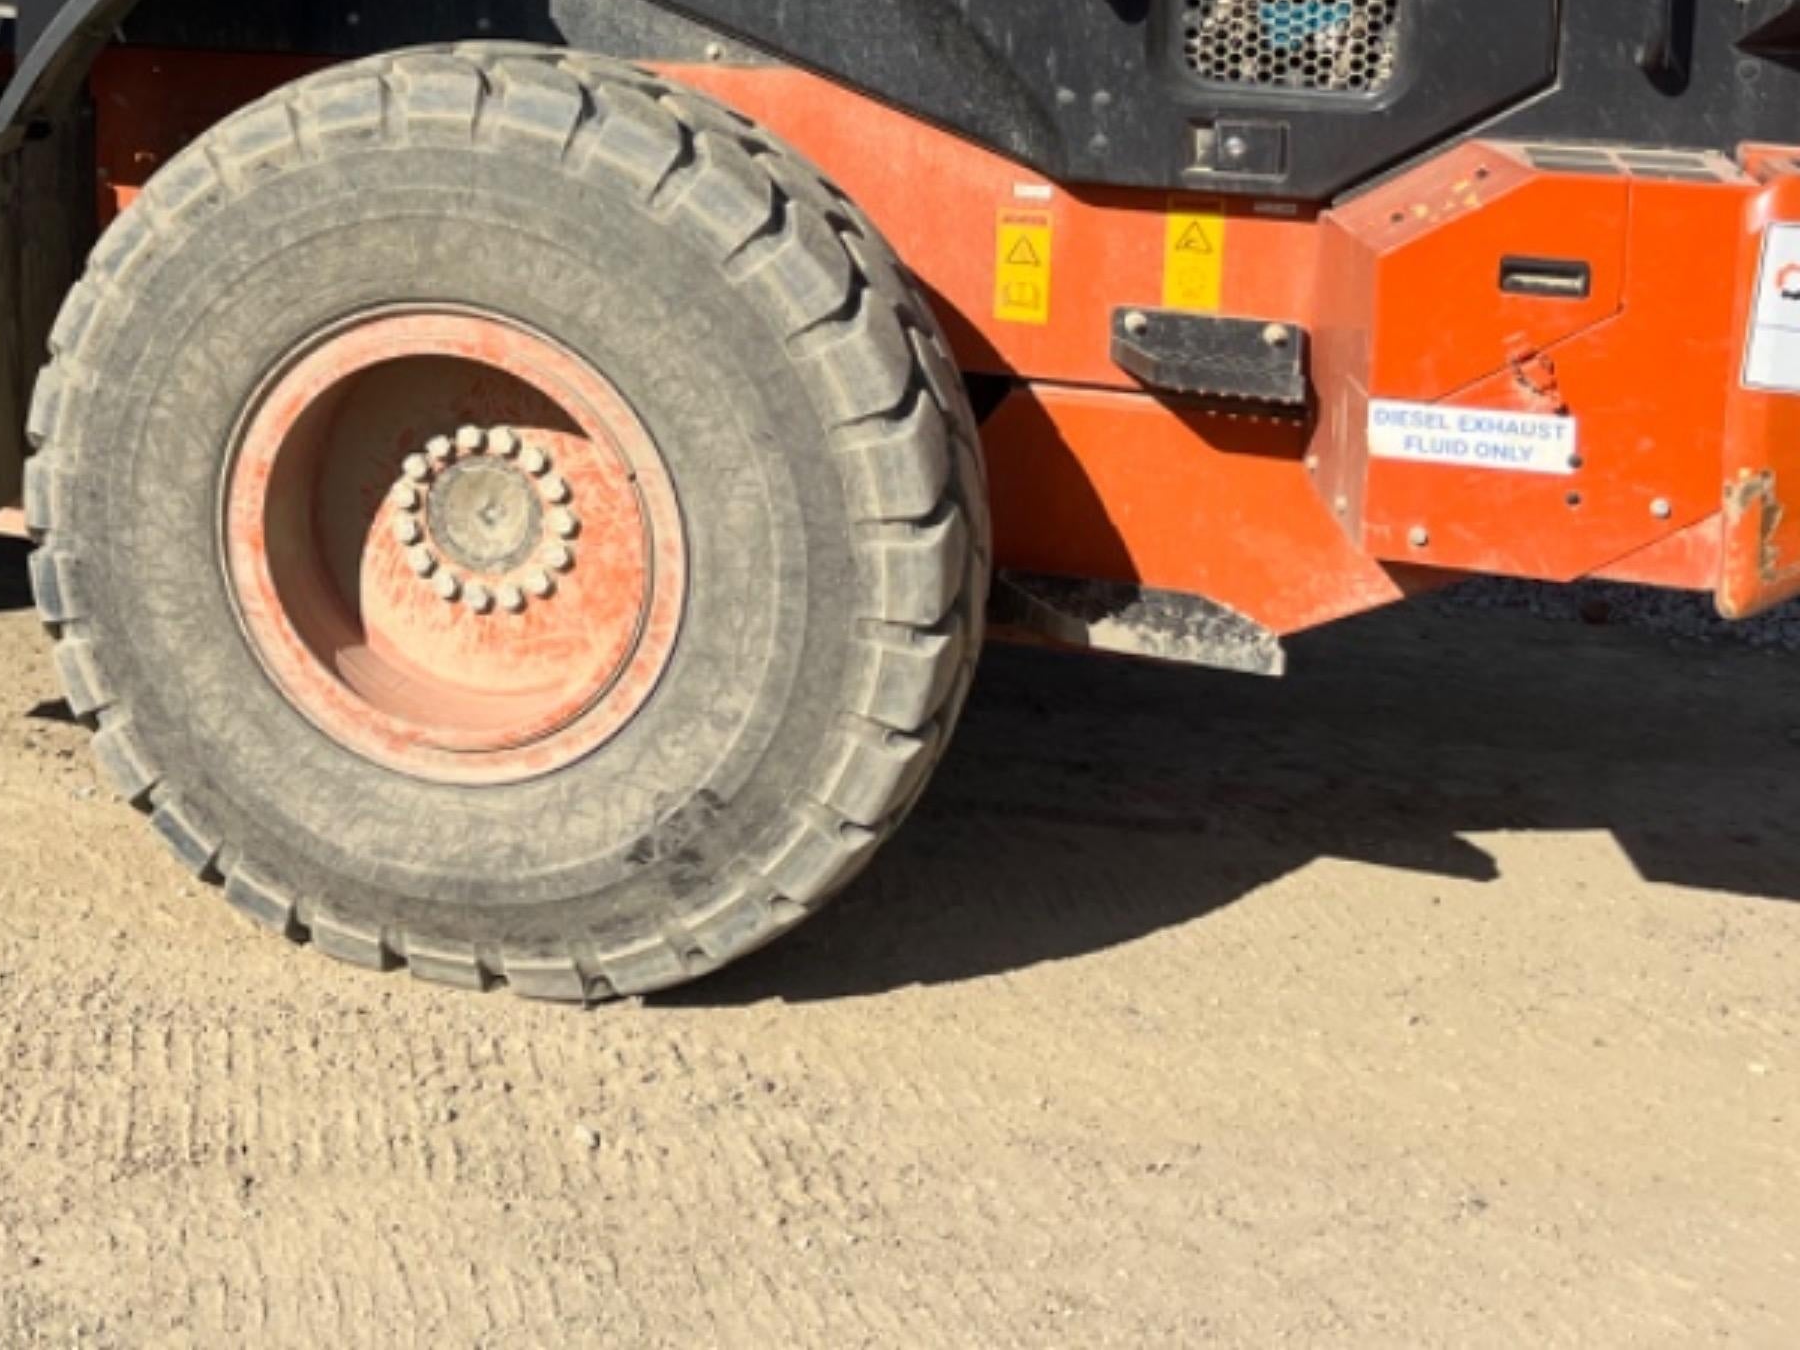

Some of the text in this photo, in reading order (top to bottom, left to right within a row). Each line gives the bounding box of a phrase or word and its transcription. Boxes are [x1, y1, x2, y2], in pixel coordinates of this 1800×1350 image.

[1374, 408, 1567, 440] DIESEL EXHAUST
[1404, 434, 1534, 462] FLUID ONLY
